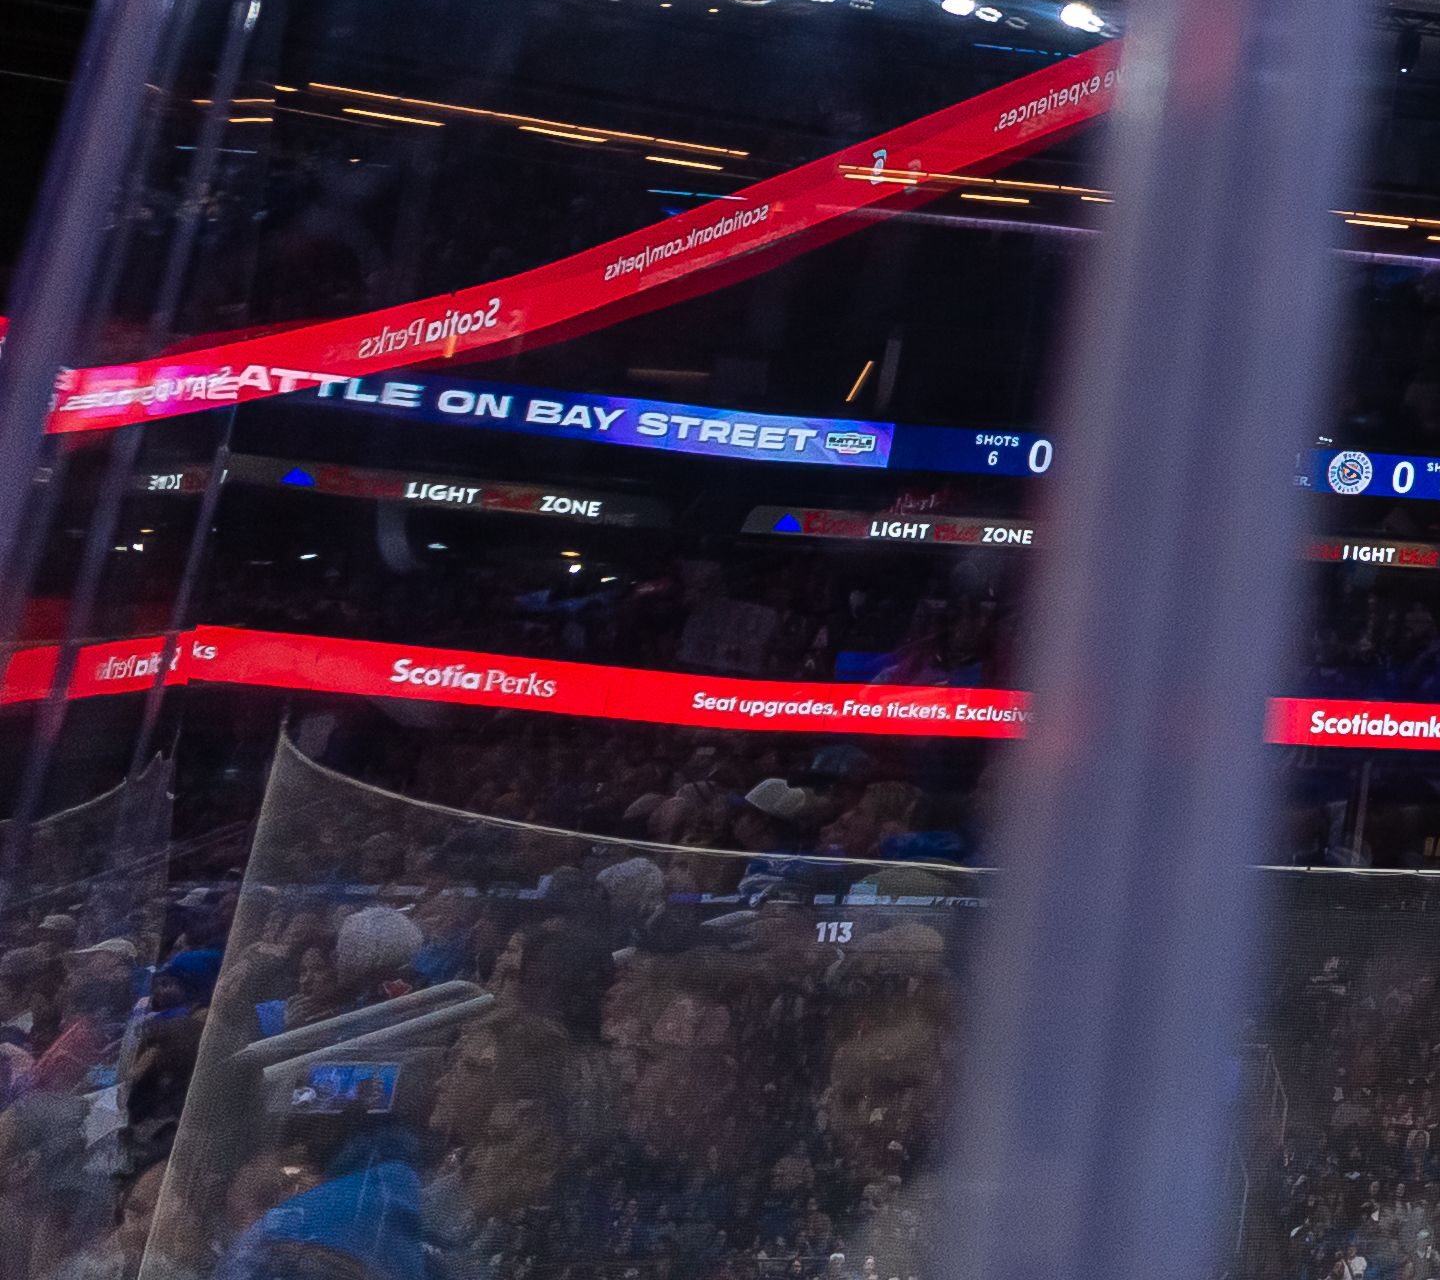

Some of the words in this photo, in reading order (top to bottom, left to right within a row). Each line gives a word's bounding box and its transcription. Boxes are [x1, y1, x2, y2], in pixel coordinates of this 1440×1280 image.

[437, 387, 514, 422] ON
[525, 400, 628, 436] BAY
[636, 411, 819, 454] STREET
[975, 433, 1020, 448] SHOTS
[1027, 438, 1054, 474] 0
[986, 450, 999, 466] 6
[1391, 460, 1416, 494] 0
[404, 481, 482, 505] LIGHT
[539, 494, 604, 518] ZONE
[869, 520, 931, 540] LIGHT
[981, 526, 1035, 545] ZONE
[693, 691, 736, 713] Seat
[738, 696, 839, 720] upgrades.
[842, 698, 883, 719] Free
[884, 700, 952, 722] tickets.
[816, 920, 854, 943] 113
